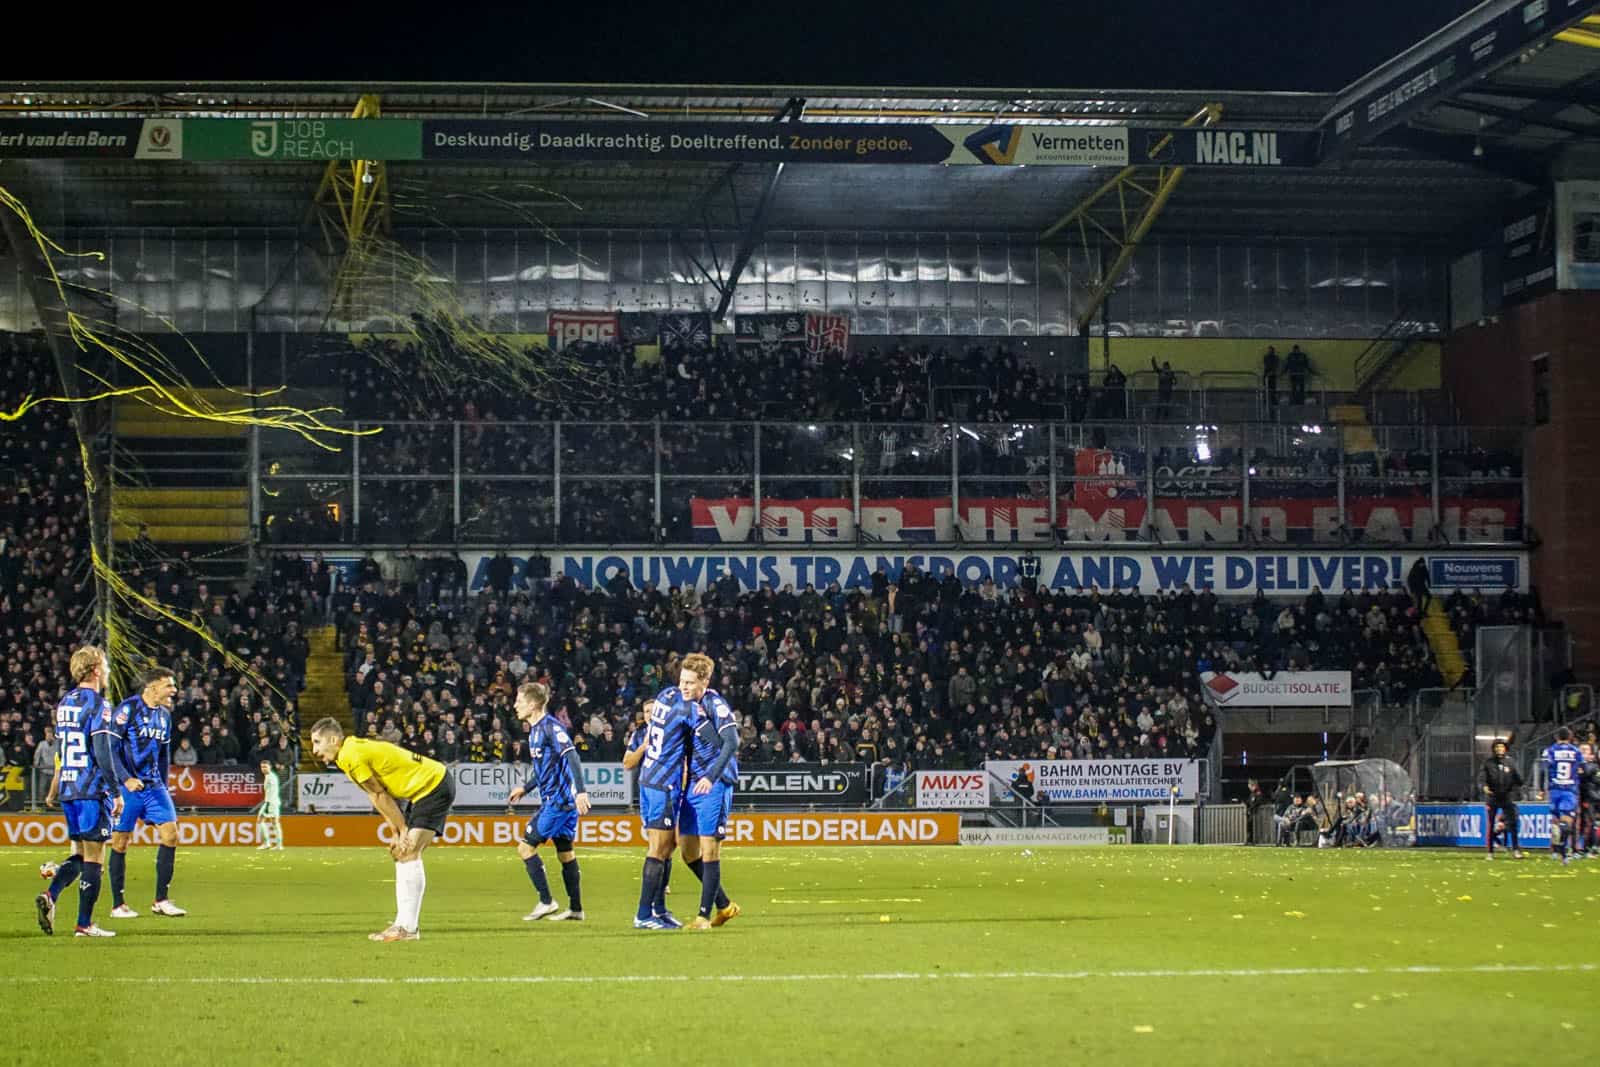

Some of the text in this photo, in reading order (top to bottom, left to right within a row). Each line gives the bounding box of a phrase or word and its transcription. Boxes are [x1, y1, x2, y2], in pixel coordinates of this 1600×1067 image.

[283, 120, 326, 138] JOB
[0, 131, 24, 147] ert
[283, 139, 354, 157] REACH
[434, 131, 913, 156] Deskundig. Daadkrachtig. Doeltreffend. Zonder gedoe.
[1031, 132, 1125, 151] Vermetten
[1196, 131, 1281, 165] NAC.NL
[707, 506, 904, 542] VOOR
[934, 506, 1287, 542] NIEMAND
[790, 556, 1019, 590] TRANPOR
[1051, 556, 1142, 589] AND
[1152, 556, 1215, 589] WE
[1225, 556, 1402, 590] DELIVER!
[1443, 562, 1503, 573] Nouwens
[139, 727, 167, 741] AVEC
[59, 730, 89, 768] 12
[203, 773, 255, 784] POWERING
[454, 768, 624, 786] CIERIN LDE
[1040, 763, 1183, 777] BAHM MONTAGE BV
[1556, 761, 1571, 779] 9
[203, 783, 263, 794] YOUR FLEET
[302, 777, 334, 796] sbr
[1040, 776, 1184, 787] ELEKTRO EN INSTALLATIETECHNIEK
[588, 789, 625, 800] nciering
[3, 821, 68, 844] VOO
[763, 818, 939, 842] NEDERLAND
